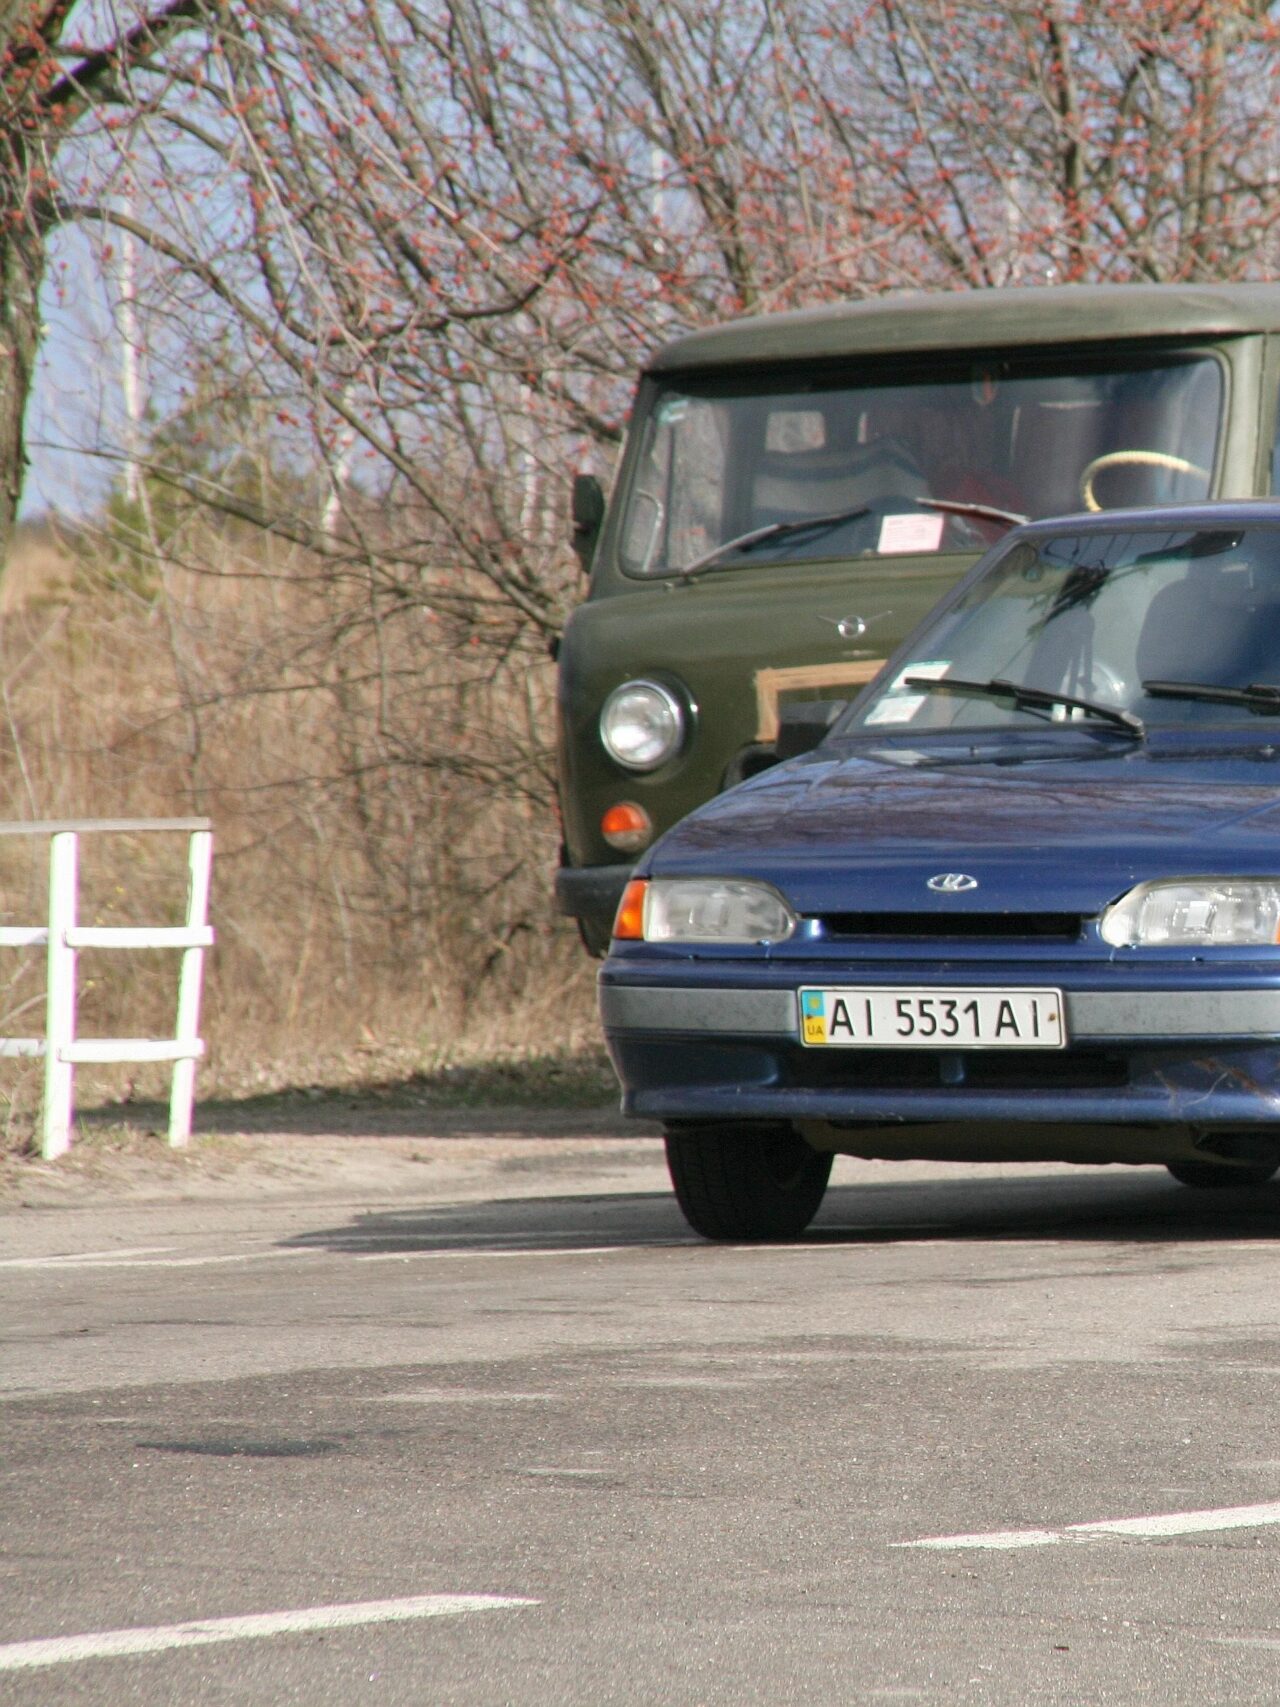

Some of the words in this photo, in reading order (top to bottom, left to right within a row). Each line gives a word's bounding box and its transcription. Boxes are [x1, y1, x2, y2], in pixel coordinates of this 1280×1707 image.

[829, 998, 873, 1037] AI
[896, 999, 981, 1037] 5531
[995, 999, 1040, 1038] AI
[807, 1026, 824, 1035] UA
